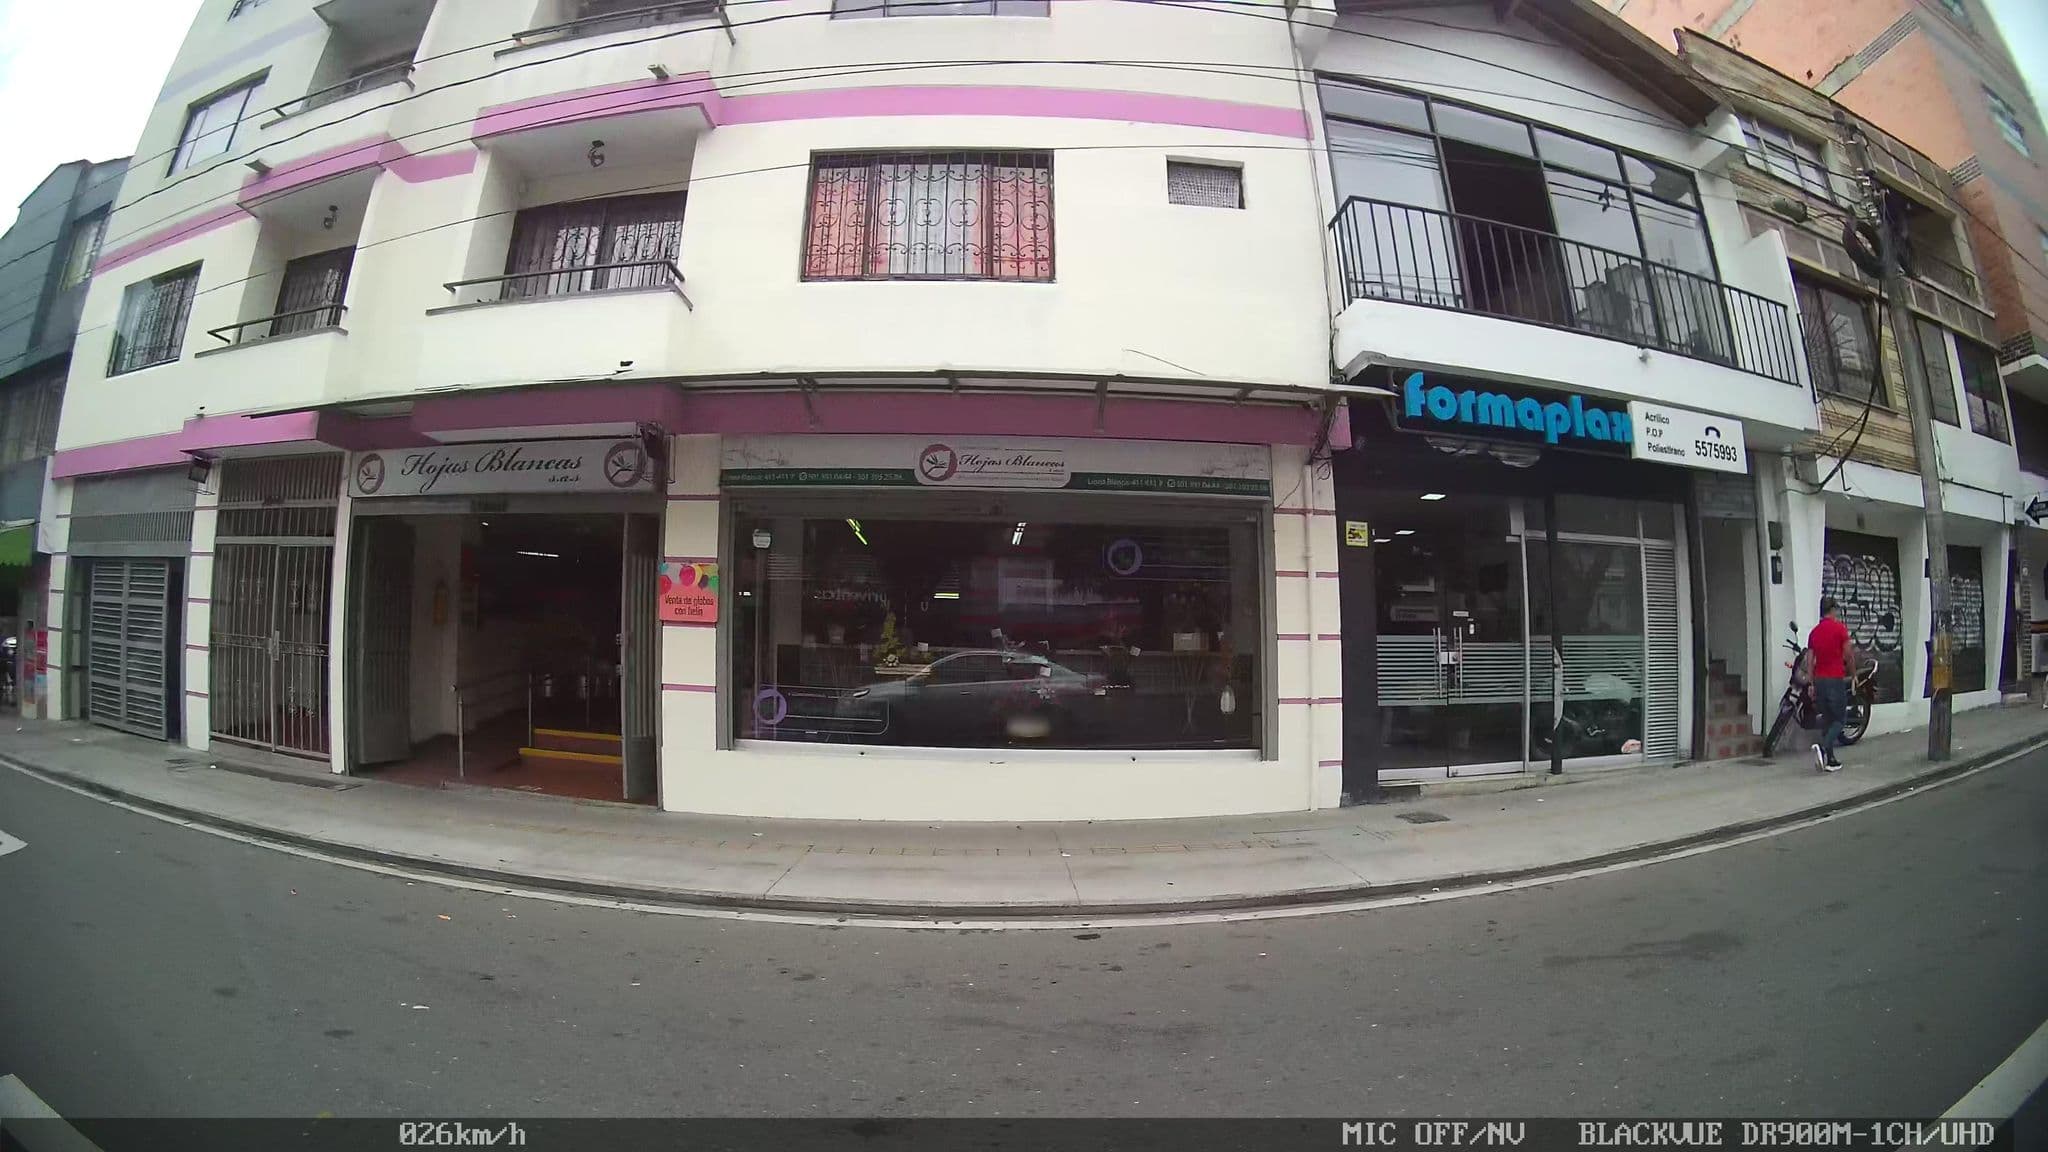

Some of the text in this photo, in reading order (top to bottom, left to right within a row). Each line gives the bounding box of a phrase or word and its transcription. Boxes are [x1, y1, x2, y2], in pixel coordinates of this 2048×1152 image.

[1695, 439, 1738, 462] 5575993
[401, 446, 583, 494] Hojas Blancas
[959, 454, 1065, 473] Hojas Blancas
[665, 595, 682, 605] Venta
[683, 596, 692, 605] de
[674, 607, 686, 615] con
